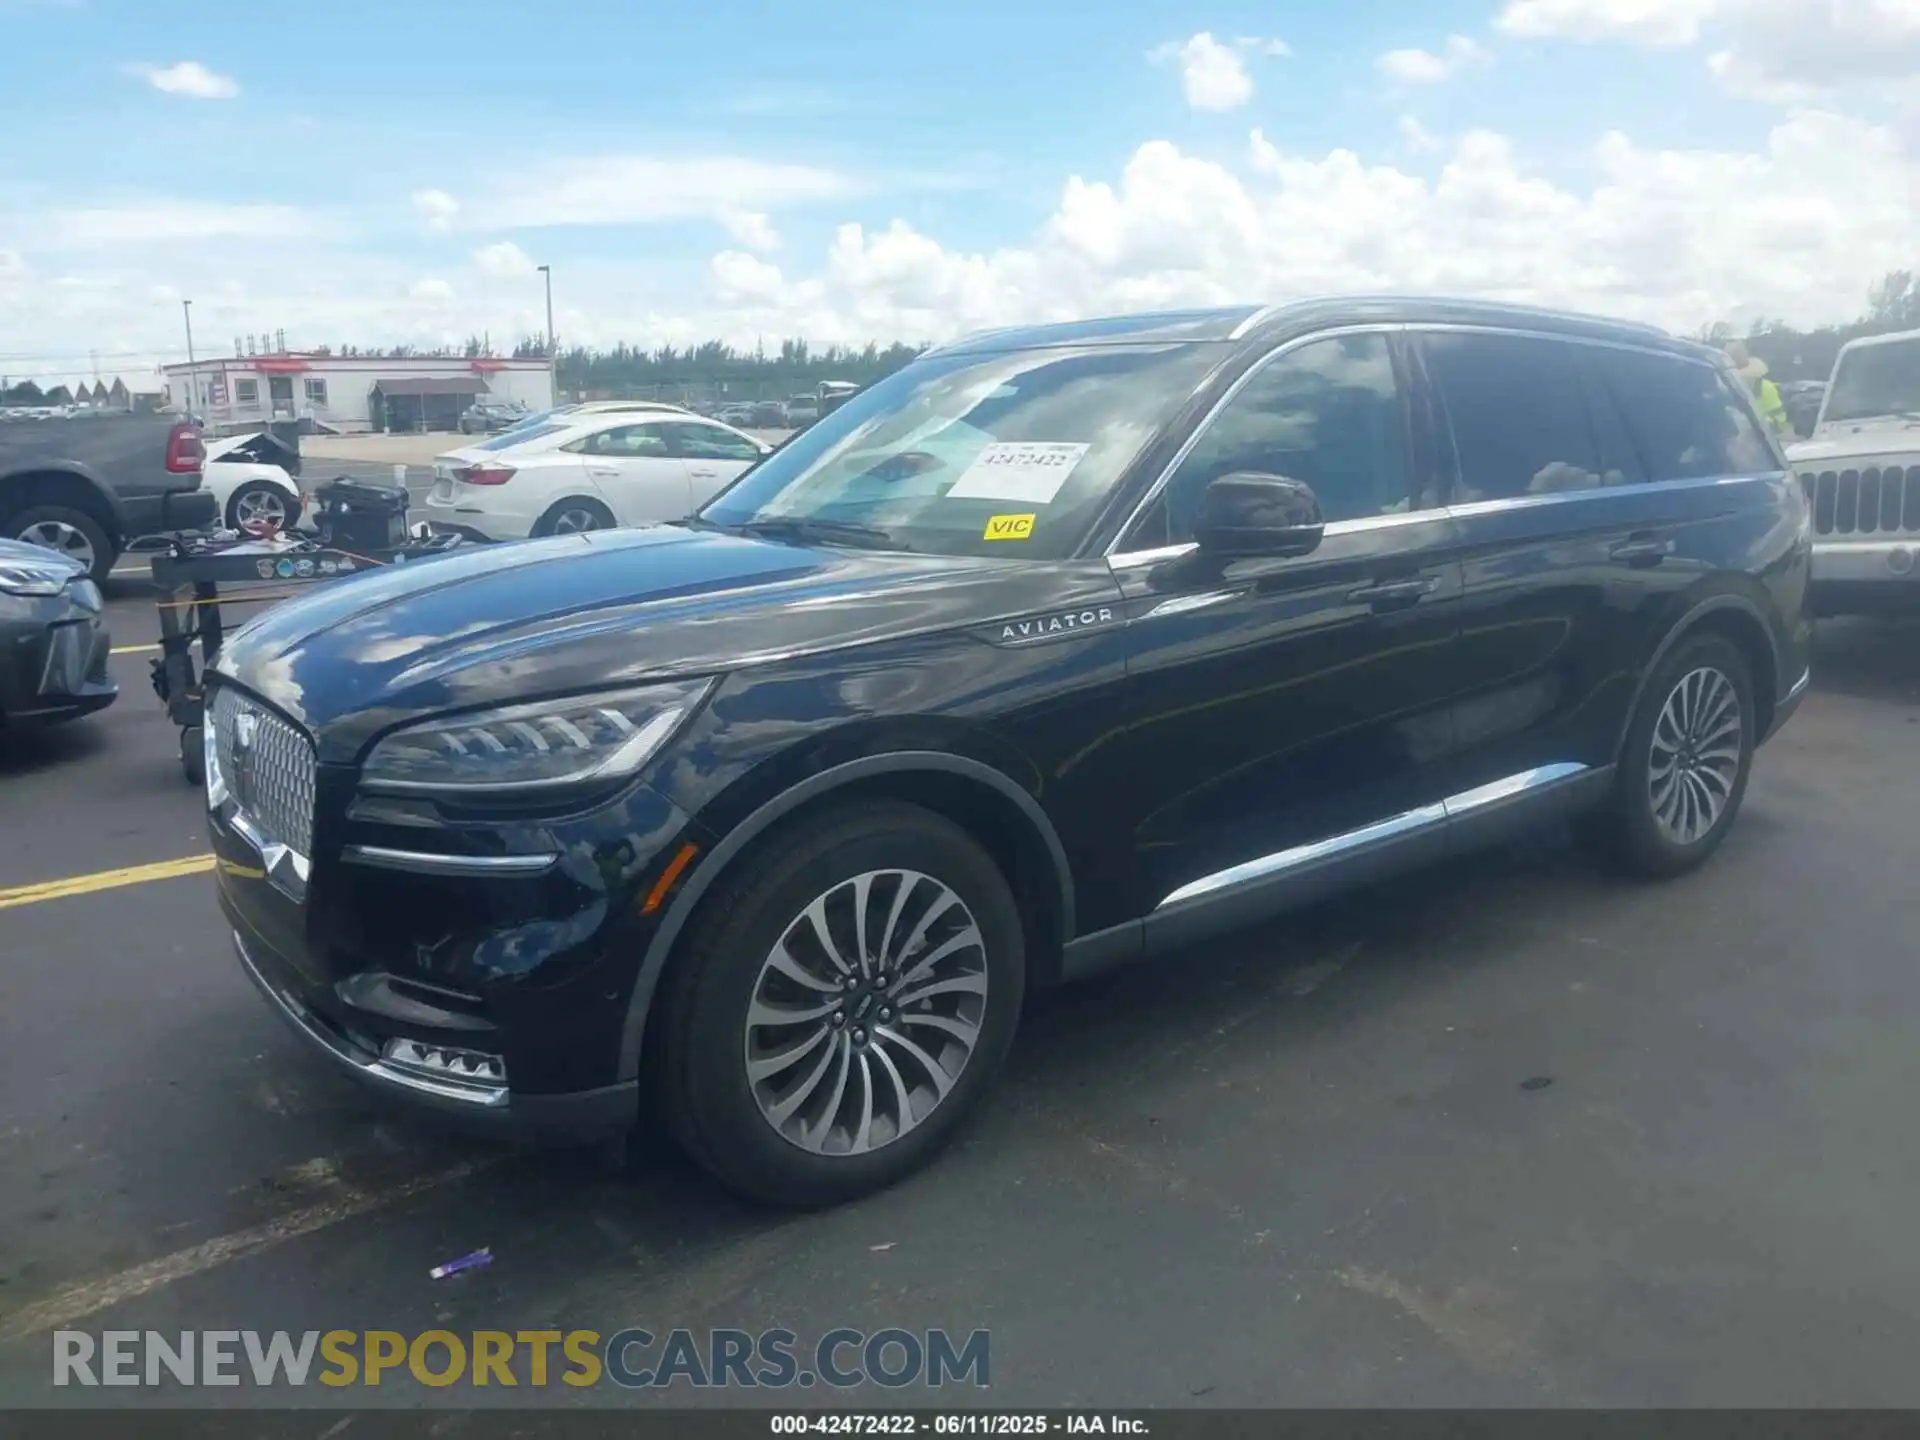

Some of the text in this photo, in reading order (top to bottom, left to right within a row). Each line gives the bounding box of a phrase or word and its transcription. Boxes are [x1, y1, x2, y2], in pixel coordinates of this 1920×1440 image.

[984, 452, 1068, 467] 42472422
[992, 519, 1030, 534] VIC
[1002, 608, 1112, 639] AVIATOR
